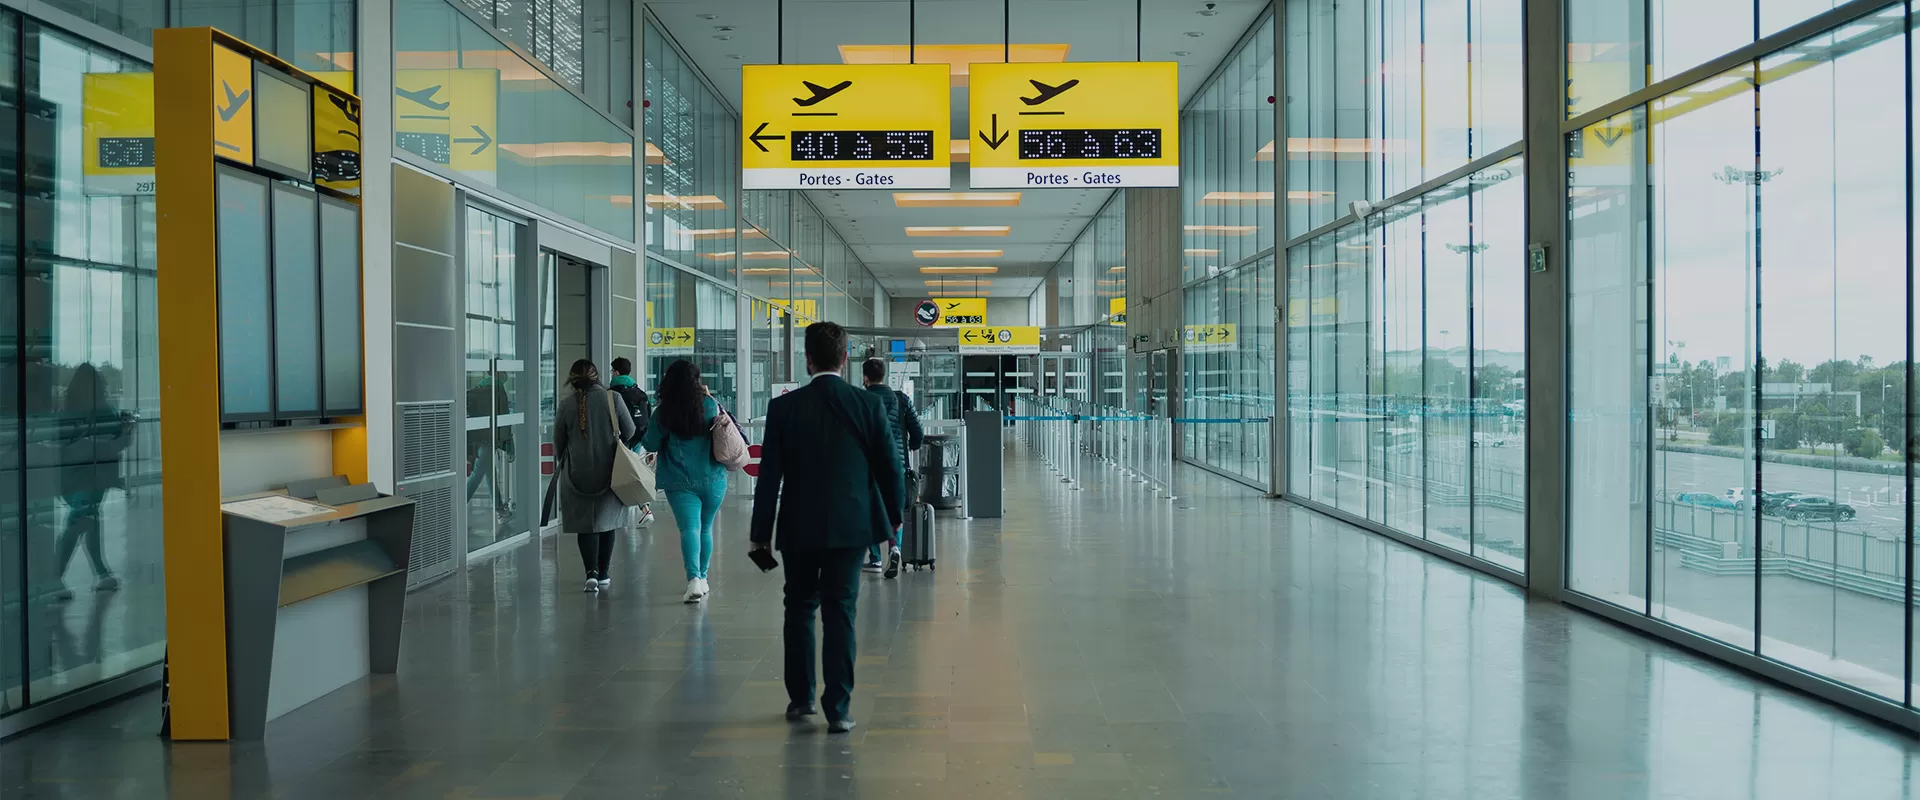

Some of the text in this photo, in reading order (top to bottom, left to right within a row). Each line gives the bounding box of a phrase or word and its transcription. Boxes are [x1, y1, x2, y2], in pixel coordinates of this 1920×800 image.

[797, 133, 928, 159] 40 à 55
[1024, 131, 1156, 157] 56 à 63
[799, 173, 842, 186] Portes
[855, 172, 894, 186] Gates
[1027, 172, 1069, 185] Portes
[1083, 172, 1121, 185] Gates
[946, 316, 959, 324] 56
[969, 316, 982, 324] 63
